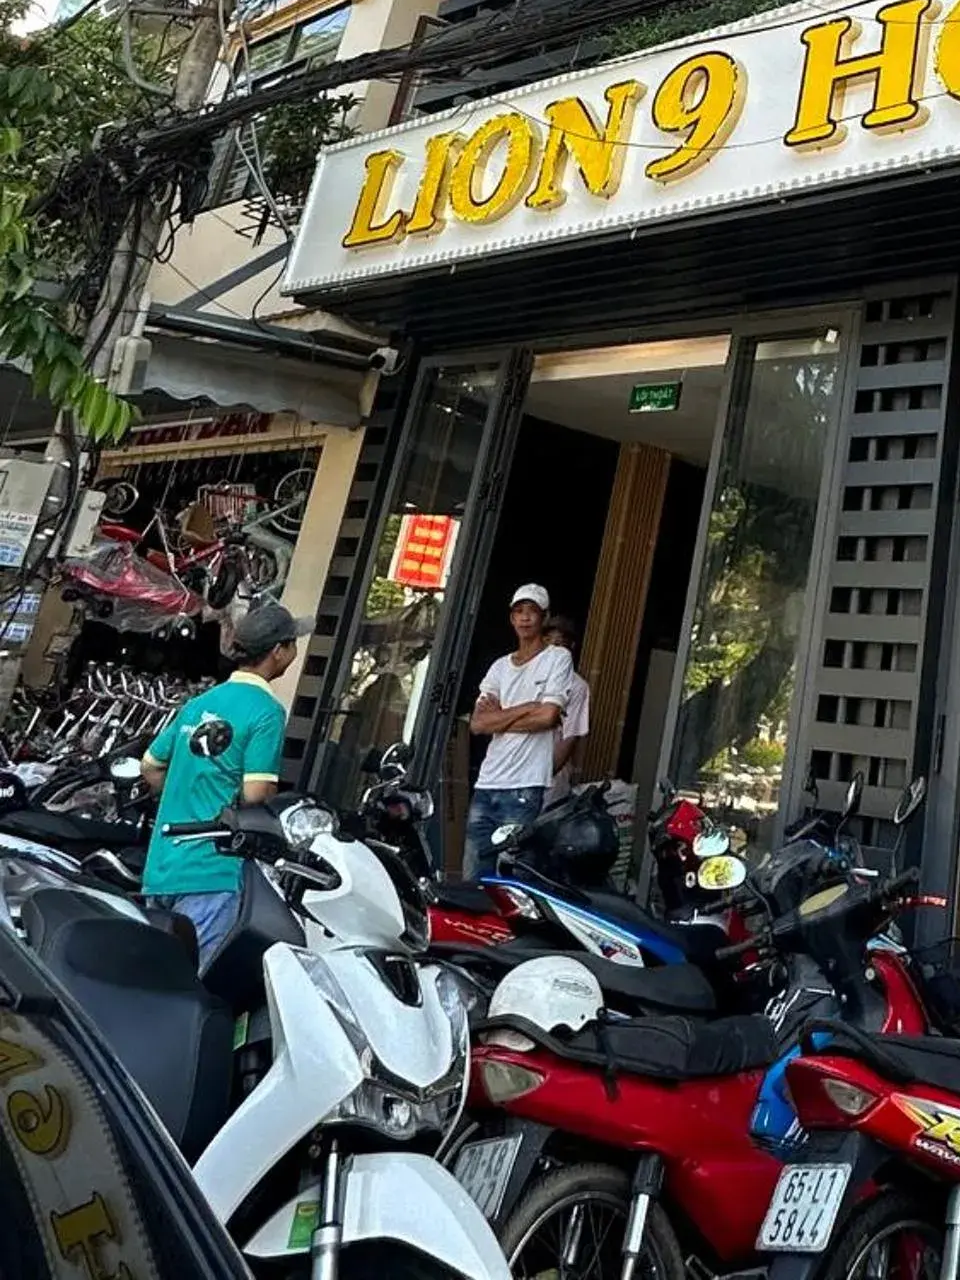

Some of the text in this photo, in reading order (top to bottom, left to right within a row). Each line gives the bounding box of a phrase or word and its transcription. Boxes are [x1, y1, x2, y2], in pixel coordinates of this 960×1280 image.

[343, 50, 744, 252] LION9
[782, 1171, 838, 1204] 65-L1
[768, 1208, 825, 1243] 5844
